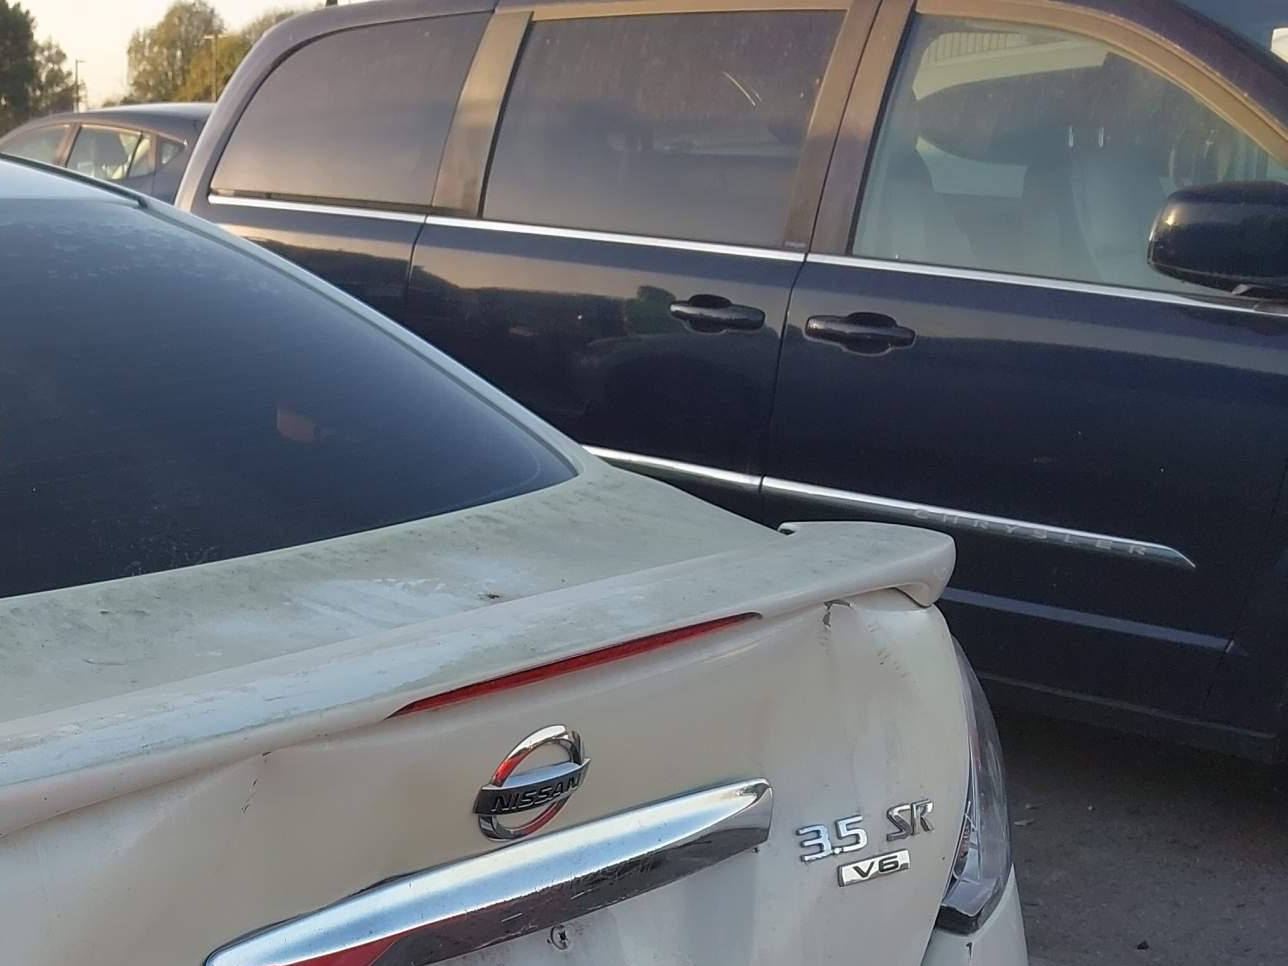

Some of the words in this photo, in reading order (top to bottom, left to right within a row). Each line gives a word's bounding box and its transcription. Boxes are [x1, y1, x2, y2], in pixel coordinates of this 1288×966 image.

[913, 509, 1147, 556] CHRYSLER
[490, 775, 582, 812] NISSAN
[796, 814, 868, 863] 3.5
[885, 799, 934, 842] SR
[851, 853, 902, 879] V6
